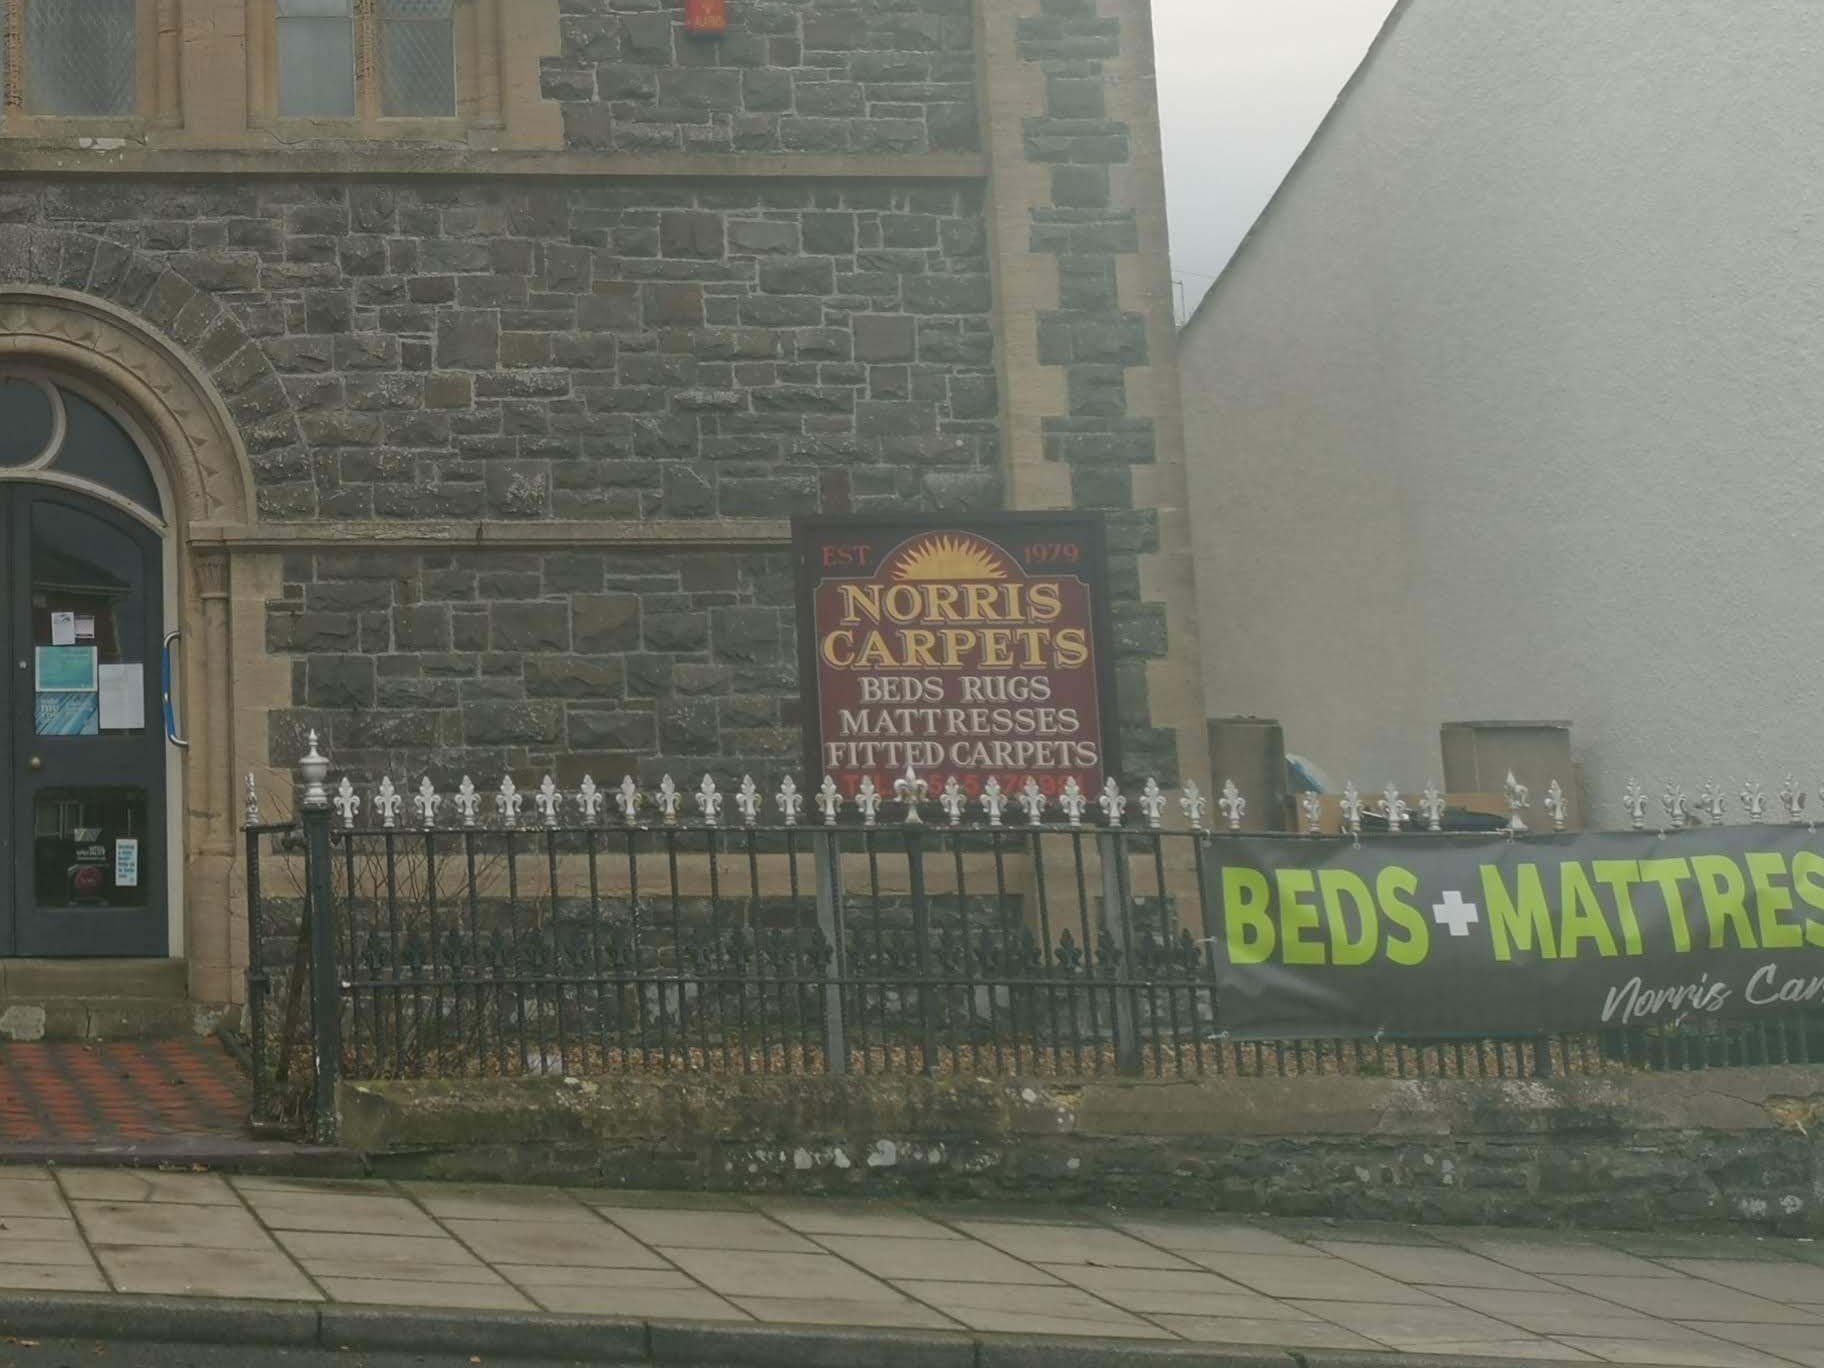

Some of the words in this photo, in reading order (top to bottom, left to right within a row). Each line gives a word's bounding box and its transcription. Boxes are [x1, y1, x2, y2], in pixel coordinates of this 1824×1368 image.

[1024, 543, 1079, 563] 1979
[837, 583, 1063, 625] NORRIS
[822, 627, 1089, 670] CARPETS
[860, 676, 945, 704] BEDS
[958, 675, 1052, 703] RUGS
[838, 708, 1081, 736] MATTRESSES
[826, 742, 945, 769] FITTED
[950, 741, 1099, 769] CARPETS
[1220, 865, 1430, 966] BEDS
[1479, 850, 1824, 961] MATTRES
[1601, 973, 1733, 1024] Norris
